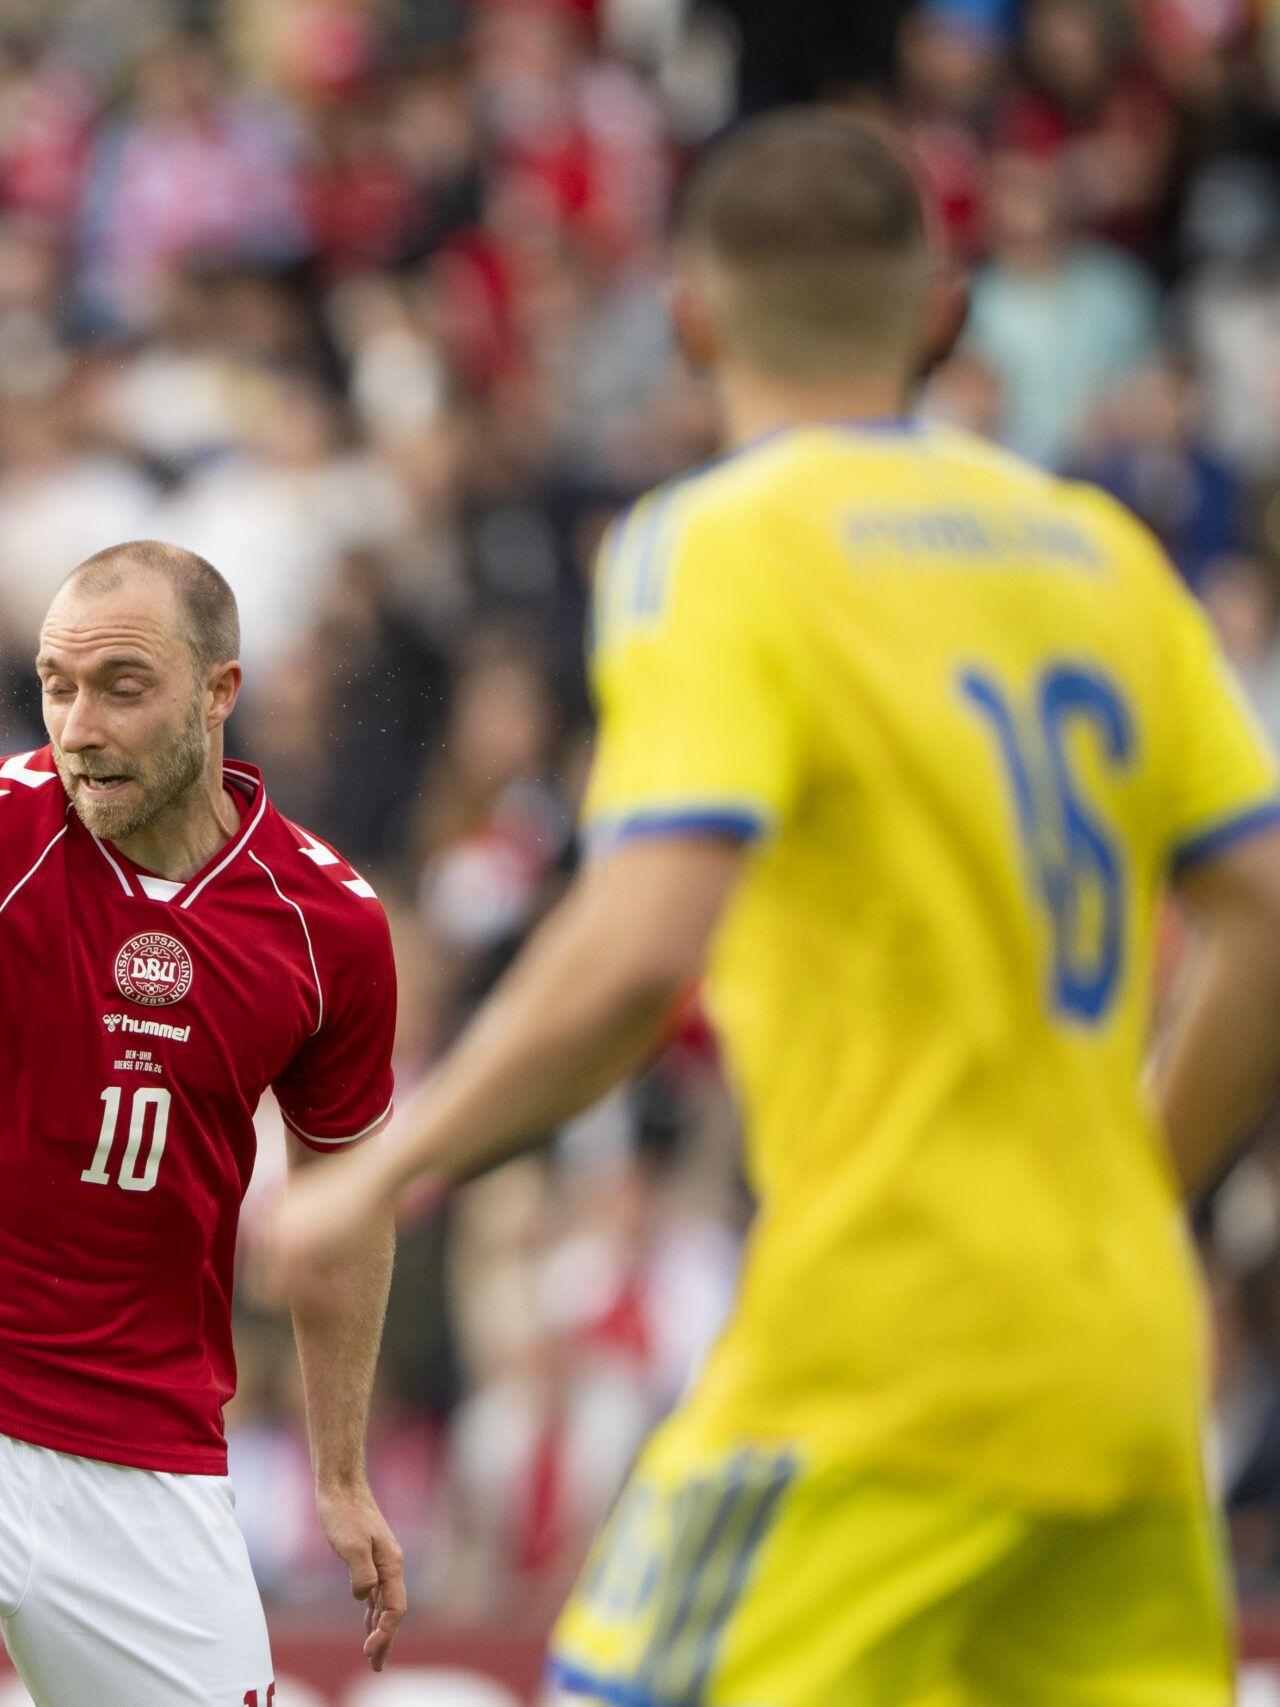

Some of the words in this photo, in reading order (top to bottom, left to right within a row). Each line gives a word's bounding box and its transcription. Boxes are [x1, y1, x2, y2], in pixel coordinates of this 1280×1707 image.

[118, 950, 134, 995] DANSK
[131, 957, 177, 983] DBU
[134, 994, 166, 1004] 1889
[121, 1014, 191, 1042] hummel
[81, 1086, 172, 1192] 10
